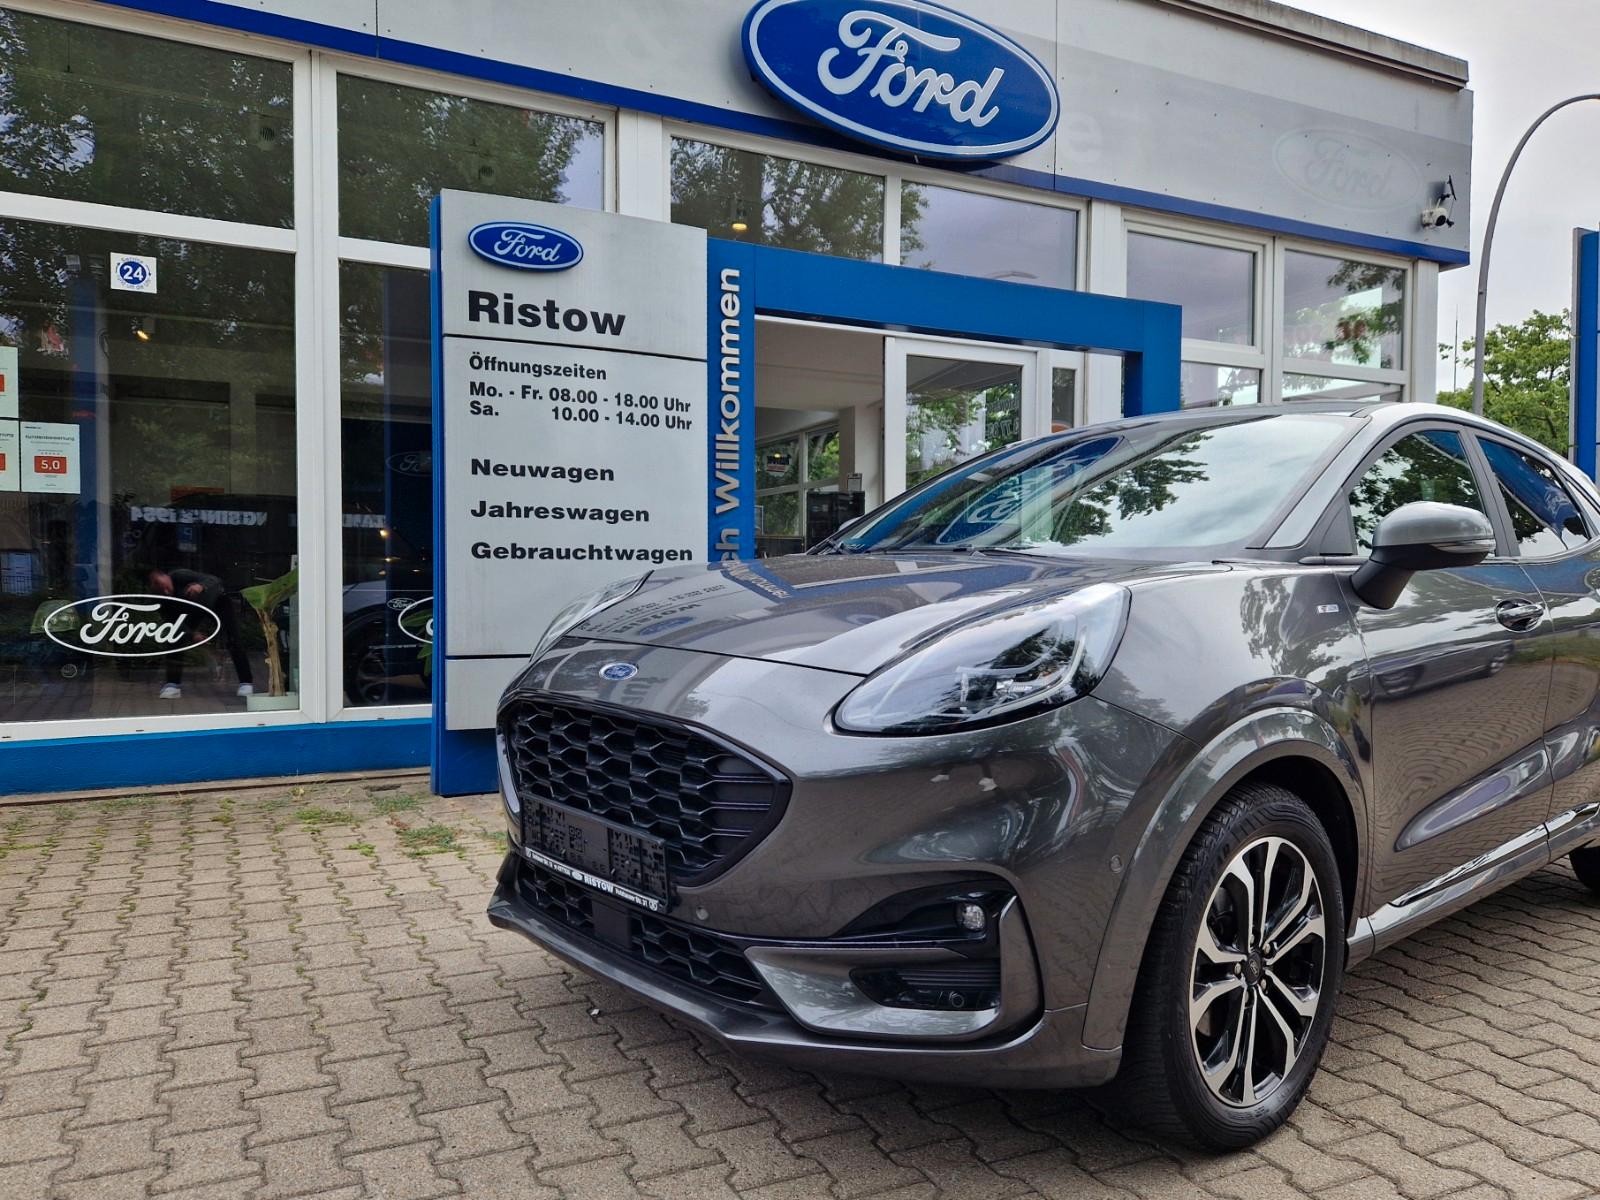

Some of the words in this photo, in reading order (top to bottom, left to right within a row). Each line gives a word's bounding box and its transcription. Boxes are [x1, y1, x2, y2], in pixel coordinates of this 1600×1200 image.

[817, 10, 1005, 127] Ford
[493, 228, 562, 263] Ford
[123, 264, 144, 281] 24
[468, 290, 626, 336] Ristow
[469, 352, 607, 380] Öffnungszeiten
[469, 381, 503, 398] Mo.
[520, 385, 543, 401] Fr.
[549, 388, 598, 405] 08.00
[614, 393, 659, 410] 18.00
[663, 397, 691, 413] Uhr
[715, 267, 741, 514] Willkommen
[470, 401, 500, 417] Sa.
[551, 407, 599, 423] 10.00
[616, 411, 660, 428] 14.00
[665, 415, 692, 430] Uhr
[41, 460, 61, 470] 5,0
[471, 458, 615, 483] Neuwagen
[471, 500, 650, 524] Jahreswagen
[471, 541, 693, 564] Gebrauchtwagen
[80, 602, 188, 645] Ford
